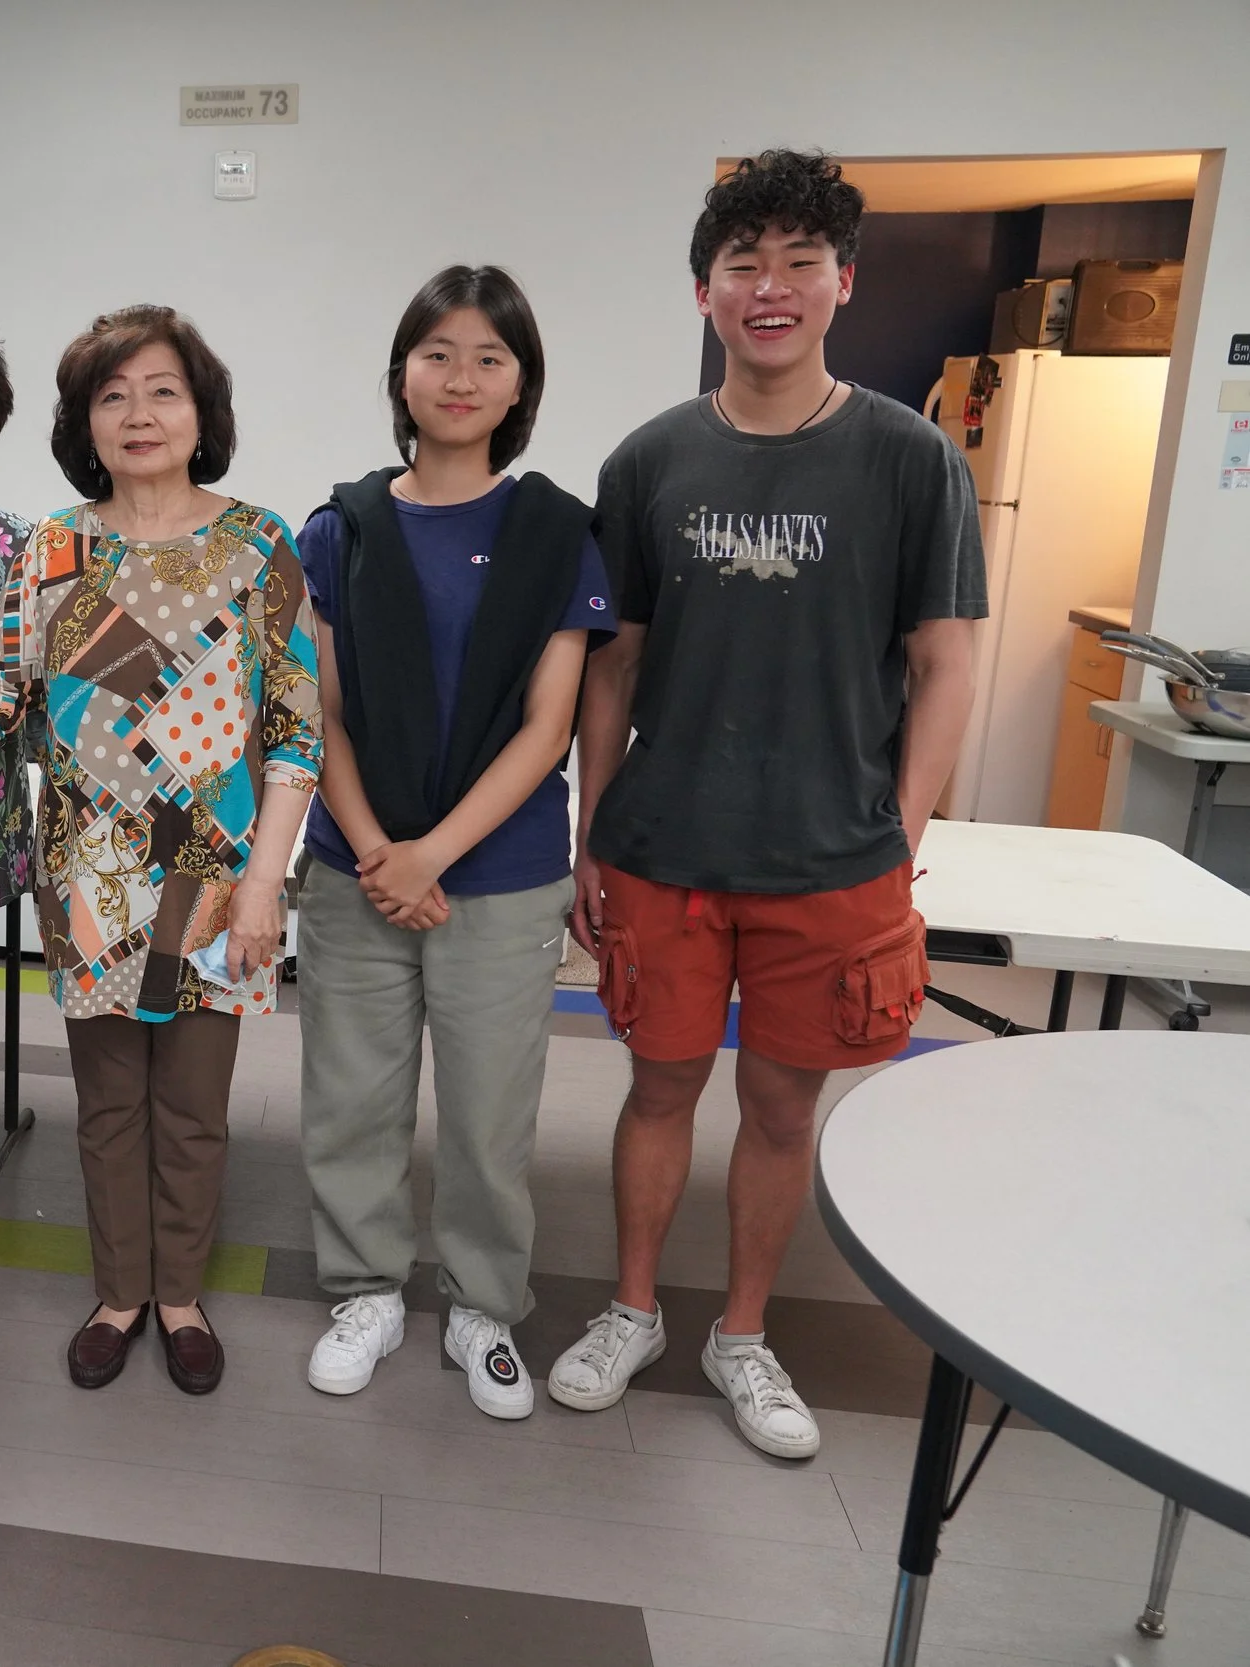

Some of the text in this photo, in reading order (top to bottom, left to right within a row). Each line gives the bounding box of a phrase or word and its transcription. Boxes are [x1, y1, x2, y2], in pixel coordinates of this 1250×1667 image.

[195, 90, 246, 102] MAXIMUM
[259, 89, 289, 117] 73
[185, 106, 254, 120] OCCUPANCY
[1234, 343, 1250, 352] Em
[1233, 352, 1250, 363] Onl
[692, 513, 827, 562] ALLSAINTS
